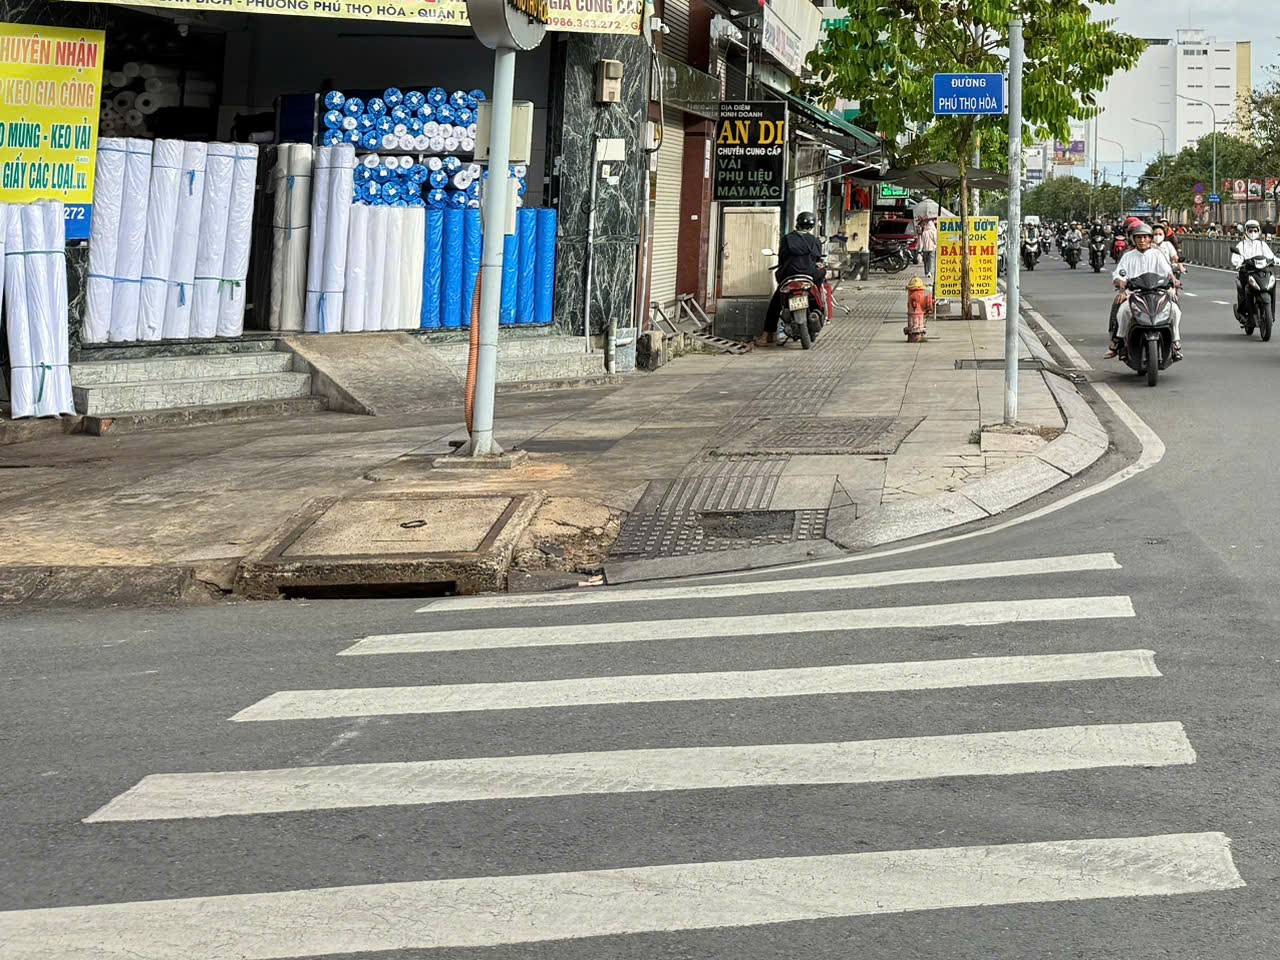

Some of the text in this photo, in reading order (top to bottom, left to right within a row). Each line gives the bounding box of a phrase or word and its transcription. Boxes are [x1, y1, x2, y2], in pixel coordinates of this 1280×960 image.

[313, 0, 341, 13] PHÚ
[346, 3, 372, 16] THỌ
[376, 3, 406, 17] HÒA
[418, 6, 455, 21] QUẬN
[0, 34, 97, 72] HUYÊN NHẬN
[951, 76, 986, 87] ĐƯỜNG
[6, 78, 95, 108] KEO GIA CÔNG
[939, 93, 997, 112] PHÚ THỌ HÒA
[51, 124, 71, 149] KEO
[717, 120, 784, 145] AN DI
[717, 145, 744, 155] CHUYÊN
[745, 147, 766, 155] CUNG
[3, 153, 27, 189] GIẤY
[29, 157, 49, 189] CÁC
[719, 156, 741, 169] VẢI
[718, 169, 773, 184] PHỤ LIỆU
[717, 184, 780, 198] MAY MẶC
[940, 219, 969, 231] BÁN
